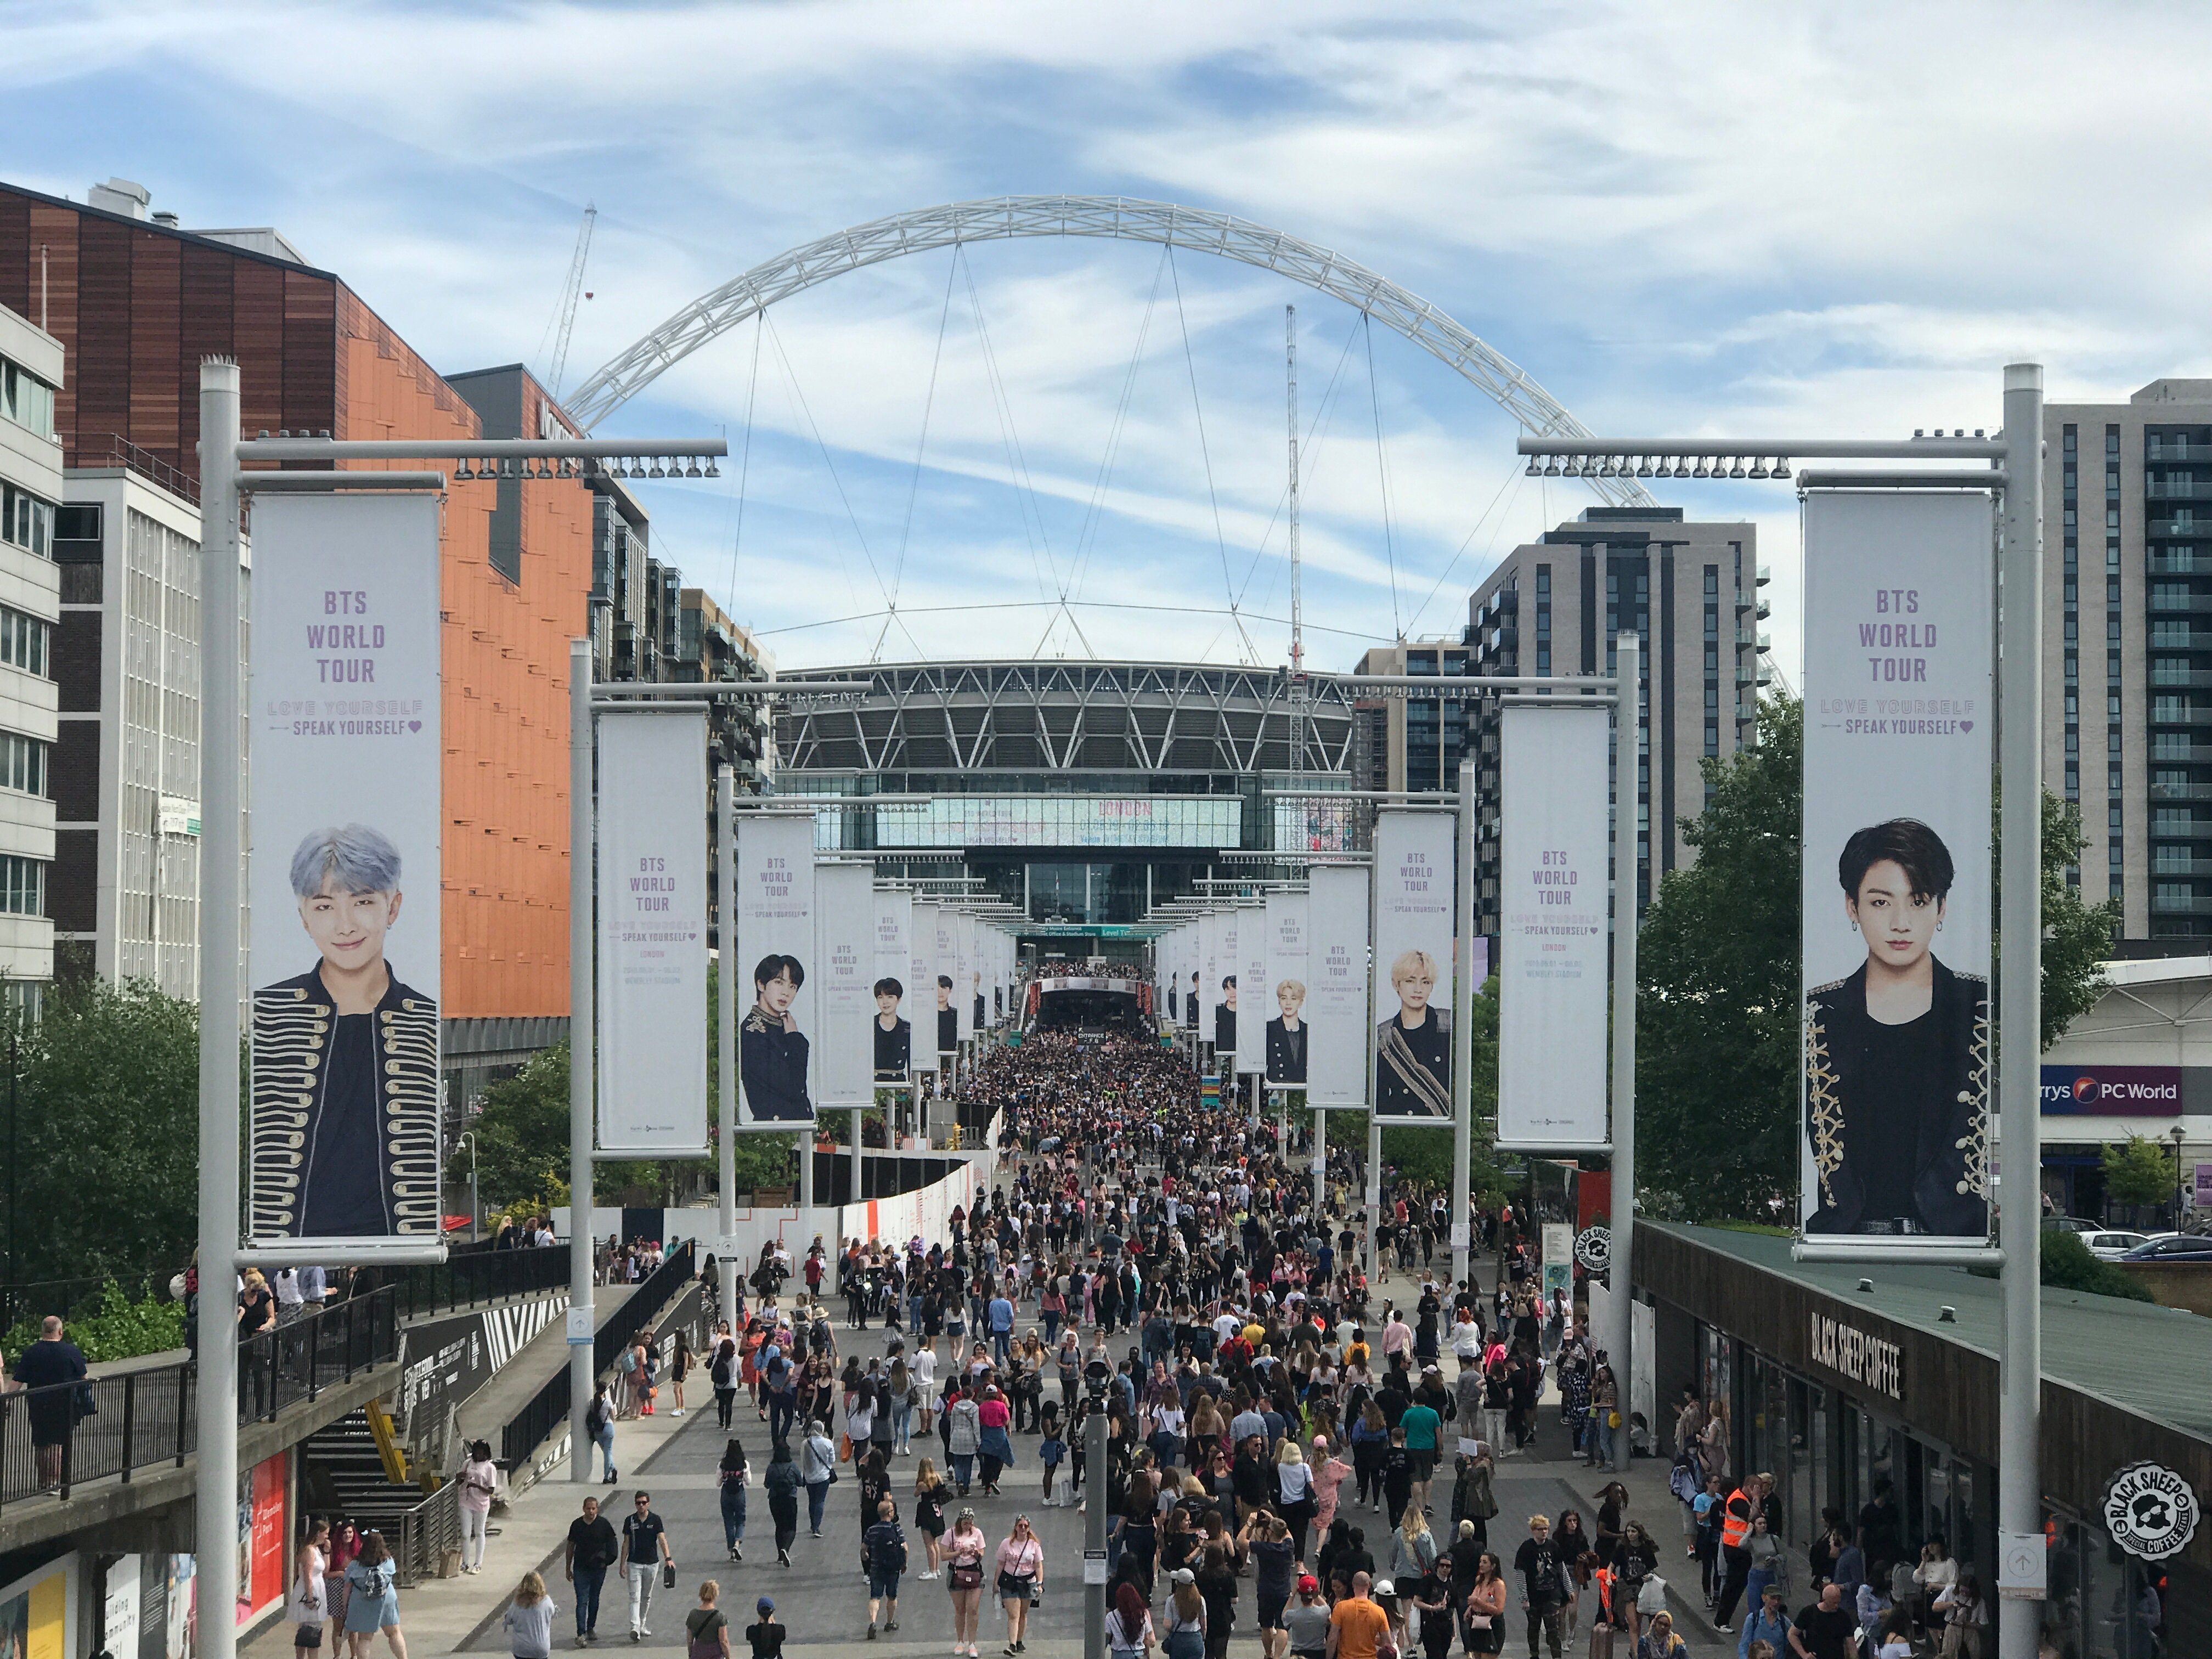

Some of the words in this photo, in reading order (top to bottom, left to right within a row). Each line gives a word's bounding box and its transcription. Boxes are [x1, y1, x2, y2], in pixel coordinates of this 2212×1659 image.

[324, 591, 366, 614] BTS
[1876, 590, 1918, 613] BTS
[307, 625, 384, 648] WORLD
[1859, 623, 1937, 648] WORLD
[317, 659, 374, 682] TOUR
[1869, 658, 1927, 682] TOUR
[267, 701, 316, 715] LOVE
[324, 699, 422, 715] YOURSELF
[1820, 698, 1868, 713] LOVE
[1876, 699, 1974, 715] YOURSELF
[293, 721, 335, 735] SPEAK
[340, 720, 405, 735] YOURSELF
[1846, 719, 1888, 733] SPEAK
[1892, 719, 1957, 735] YOURSELF
[1099, 801, 1152, 816] LONDON
[640, 858, 664, 871] BTS
[768, 858, 785, 868] BTS
[1408, 853, 1425, 863] BTS
[1543, 851, 1567, 865] BTS
[760, 872, 792, 882] WORLD
[1401, 867, 1432, 877] WORLD
[1533, 871, 1577, 885] WORLD
[630, 878, 675, 891] WORLD
[765, 886, 788, 896] TOUR
[1404, 881, 1428, 891] TOUR
[636, 897, 669, 911] TOUR
[1538, 890, 1571, 905] TOUR
[622, 933, 647, 941] SPEAK
[649, 933, 687, 941] YOURSELF
[1525, 926, 1549, 935] SPEAK
[1551, 926, 1588, 935] YOURSELF
[1331, 946, 1345, 954] BTS
[1325, 957, 1351, 965] WORLD
[835, 967, 854, 975] TOUR
[1329, 967, 1347, 976] TOUR
[2040, 1085, 2070, 1101] rrys
[2101, 1084, 2125, 1098] PC
[2127, 1084, 2177, 1099] World
[1577, 1231, 1593, 1250] BLACK
[1812, 1312, 1837, 1370] BLACK
[1839, 1323, 1864, 1383] SHEEP
[1865, 1335, 1900, 1400] COFFEE
[2110, 1476, 2142, 1518] BLACK
[2140, 1471, 2183, 1496] SHEEP
[2125, 1534, 2146, 1549] SPECIAL
[2147, 1530, 2182, 1553] COFFEE
[2178, 1512, 2188, 1532] BEANS
[105, 1598, 128, 1620] uilding
[105, 1614, 136, 1641] ommunity
